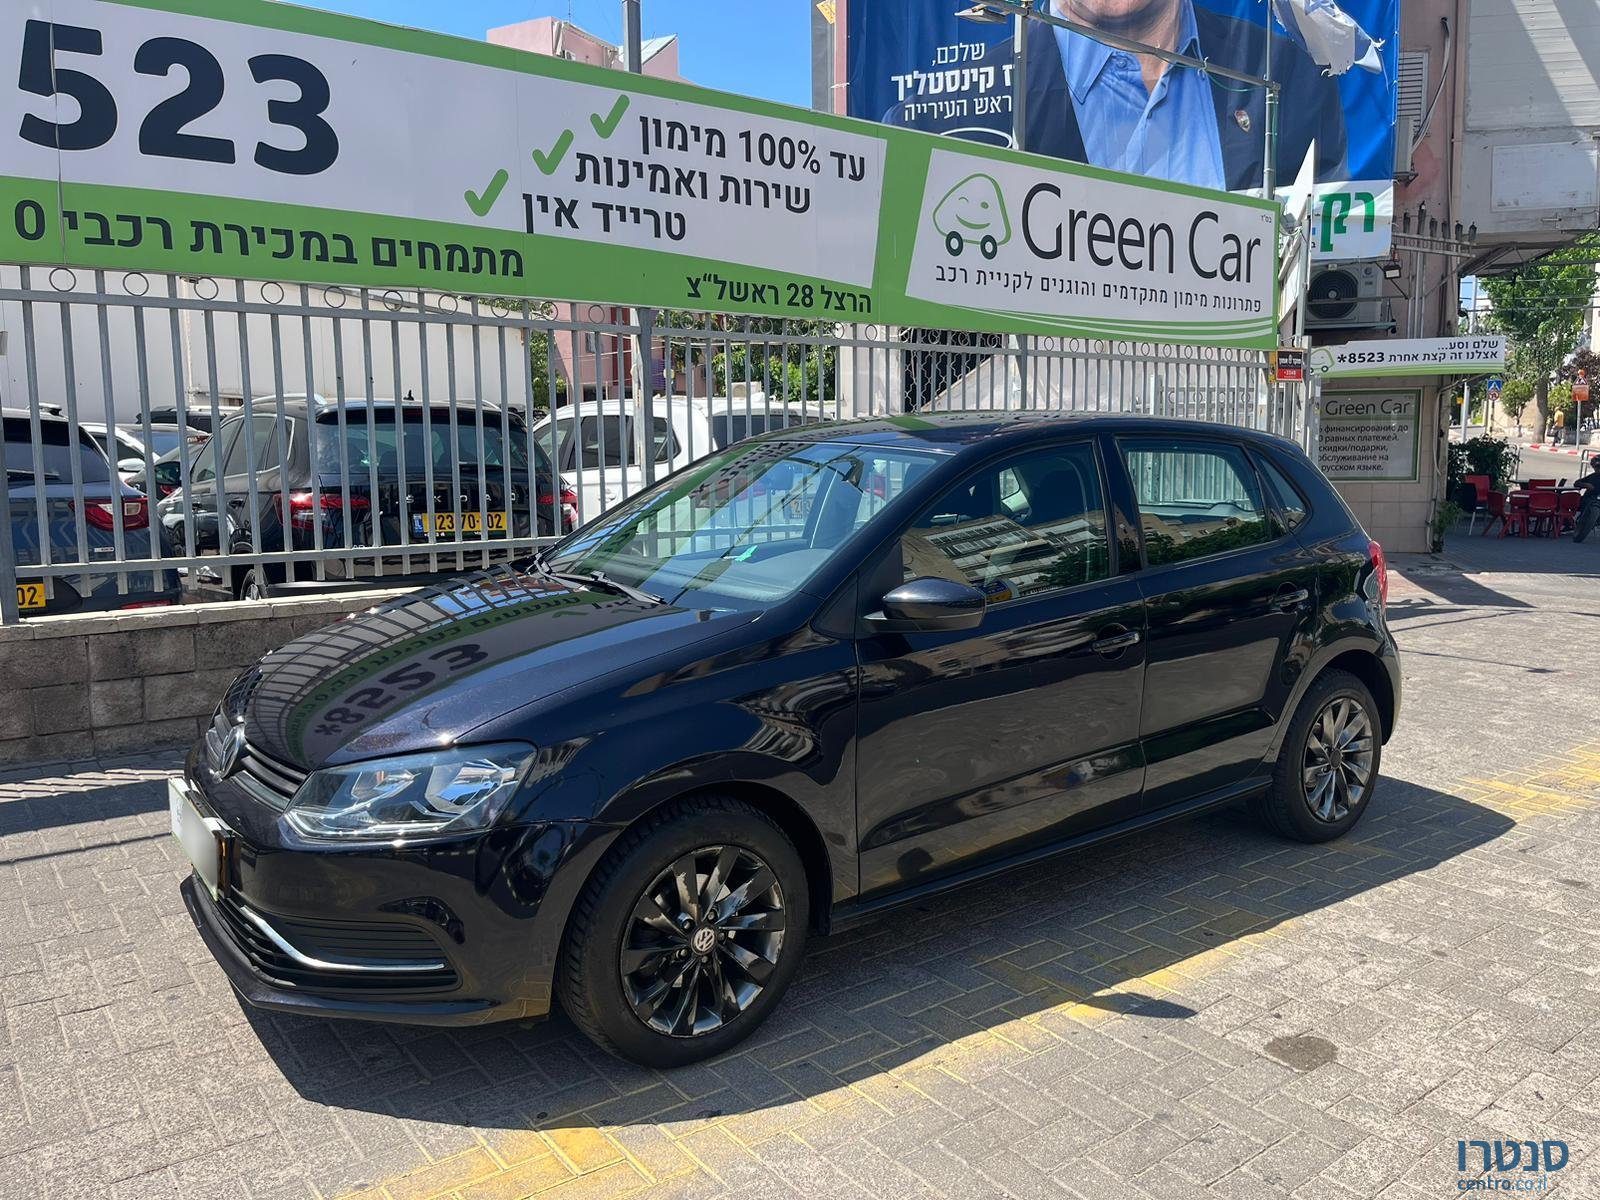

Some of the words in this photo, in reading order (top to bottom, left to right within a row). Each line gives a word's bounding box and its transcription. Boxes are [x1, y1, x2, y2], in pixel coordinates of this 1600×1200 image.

[931, 42, 985, 66] שלכם,
[891, 66, 995, 101] קינסטליך
[904, 99, 967, 121] העירייה
[973, 95, 1012, 115] ראש
[639, 115, 726, 159] מימון
[738, 130, 821, 175] 100%
[575, 152, 708, 200] ואמינות
[829, 150, 865, 182] עד
[718, 174, 811, 214] שירות
[14, 199, 46, 241] 0
[522, 192, 580, 234] אין
[591, 201, 687, 241] טרייד
[1319, 191, 1376, 252] רק
[63, 210, 174, 250] רכבי
[189, 220, 358, 265] במכירת
[1021, 182, 1175, 274] Green
[1188, 210, 1261, 284] Car
[371, 236, 524, 278] מתמחים
[935, 265, 968, 284] רכב
[975, 269, 1033, 294] לקניית
[1040, 276, 1096, 297] והוגנים
[786, 282, 814, 308] 28
[820, 284, 872, 314] הרצל
[1103, 283, 1168, 306] מתקדמים
[1174, 291, 1208, 309] מימון
[1212, 295, 1261, 313] פתרונות
[1450, 351, 1463, 360] זה
[1466, 350, 1498, 359] אצלנו
[1473, 339, 1499, 349] שלם
[1389, 353, 1419, 362] אחרת
[1422, 352, 1446, 362] קצת
[1325, 401, 1375, 415] Green
[1381, 399, 1410, 414] Car
[1325, 435, 1355, 444] равных
[1322, 463, 1355, 472] русском
